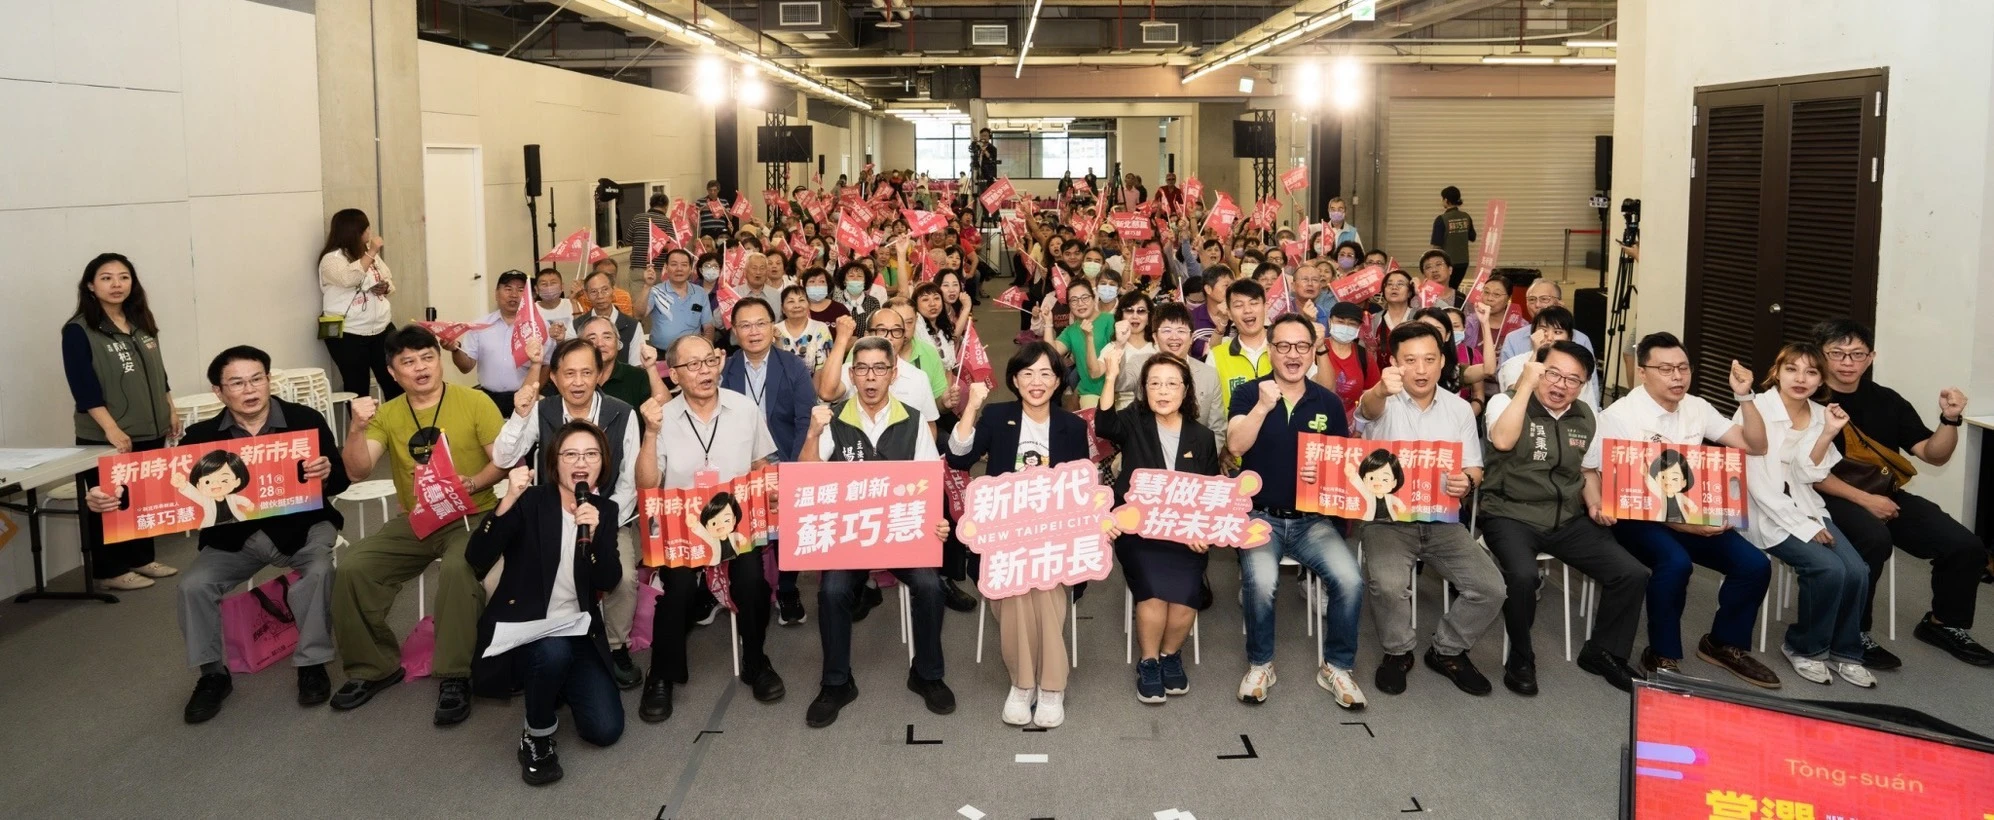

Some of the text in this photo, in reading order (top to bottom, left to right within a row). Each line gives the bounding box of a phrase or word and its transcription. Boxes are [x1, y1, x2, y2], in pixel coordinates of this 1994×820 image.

[240, 437, 312, 466] 新市長
[1305, 441, 1363, 466] 新時代
[1398, 447, 1455, 470] 新市長
[1687, 451, 1742, 473] 新市長
[110, 453, 193, 485] 新時代
[444, 486, 468, 512] 2026
[645, 496, 703, 517] 新時代
[793, 476, 890, 509] 溫暖 創新
[972, 467, 1090, 524] 新時代
[1129, 472, 1236, 512] 慧做事
[1319, 492, 1361, 511] 蘇巧慧
[136, 505, 196, 530] 蘇巧慧
[793, 500, 928, 556] 蘇巧慧
[977, 514, 1101, 545] NEW TAIPEI CITY
[664, 544, 707, 560] 蘇巧慧
[987, 533, 1104, 591] 新市長
[1785, 758, 1924, 794] Tòng-suán
